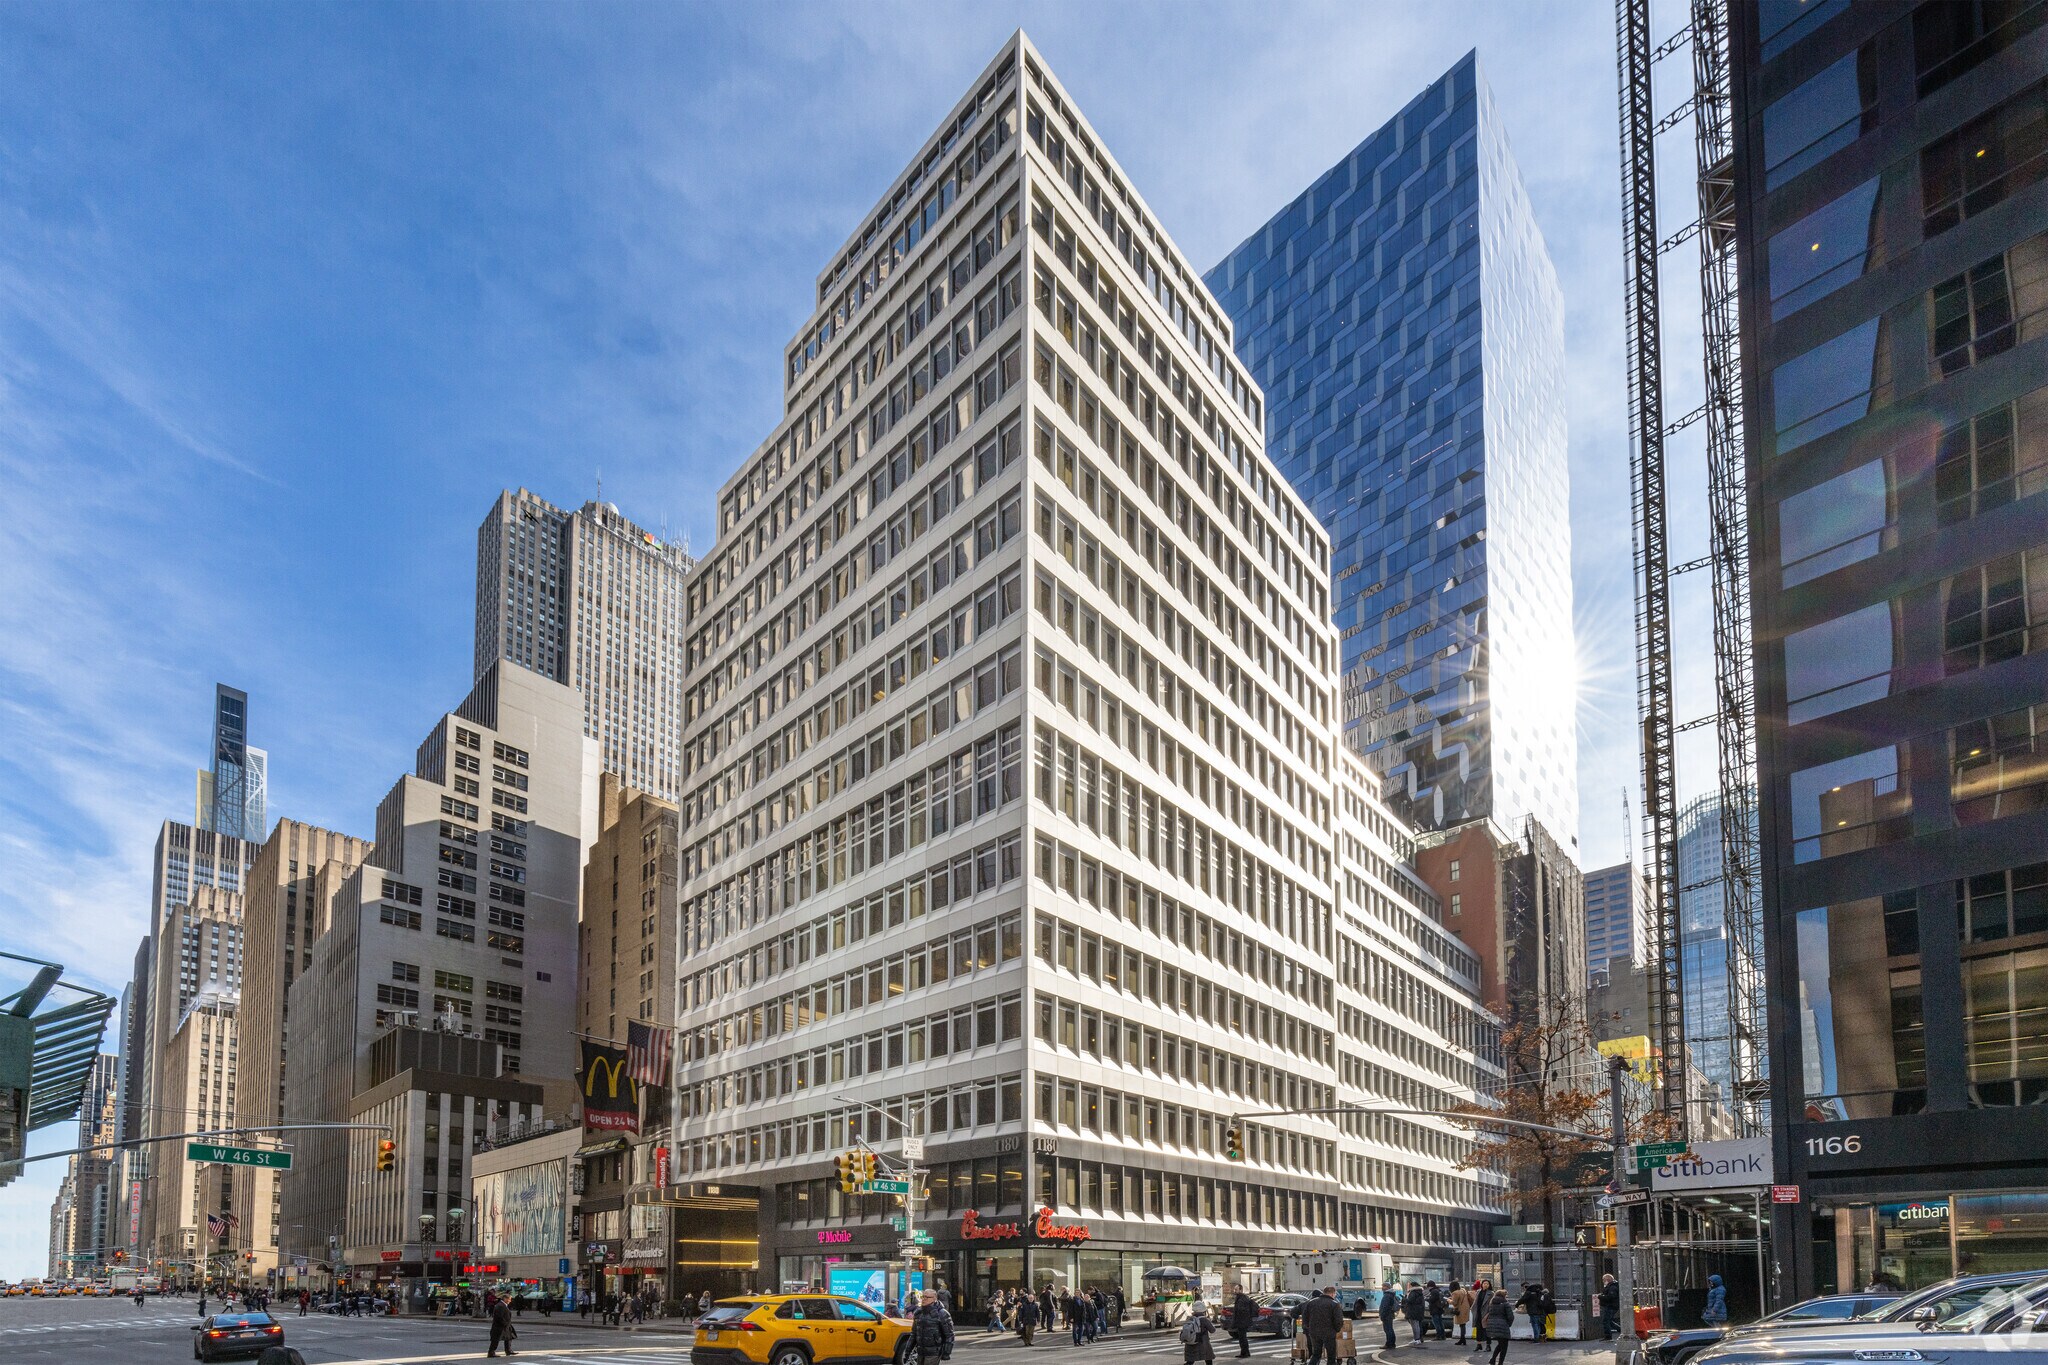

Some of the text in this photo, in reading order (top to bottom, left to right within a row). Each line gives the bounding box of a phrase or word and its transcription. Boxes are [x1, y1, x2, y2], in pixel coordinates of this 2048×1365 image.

[589, 1114, 612, 1125] OPEN
[614, 1117, 625, 1125] 24
[995, 1136, 1019, 1152] 1180
[1036, 1137, 1058, 1152] 1180
[1805, 1135, 1861, 1156] 1166
[213, 1148, 270, 1164] W 46 St
[1643, 1158, 1649, 1167] 6
[1657, 1154, 1762, 1179] citibank
[873, 1181, 879, 1189] W
[132, 1183, 140, 1214] RADIO
[1602, 1193, 1642, 1205] ONE WAY
[1899, 1203, 1949, 1219] citiban
[624, 1248, 664, 1259] McDonald's
[867, 1330, 873, 1341] T
